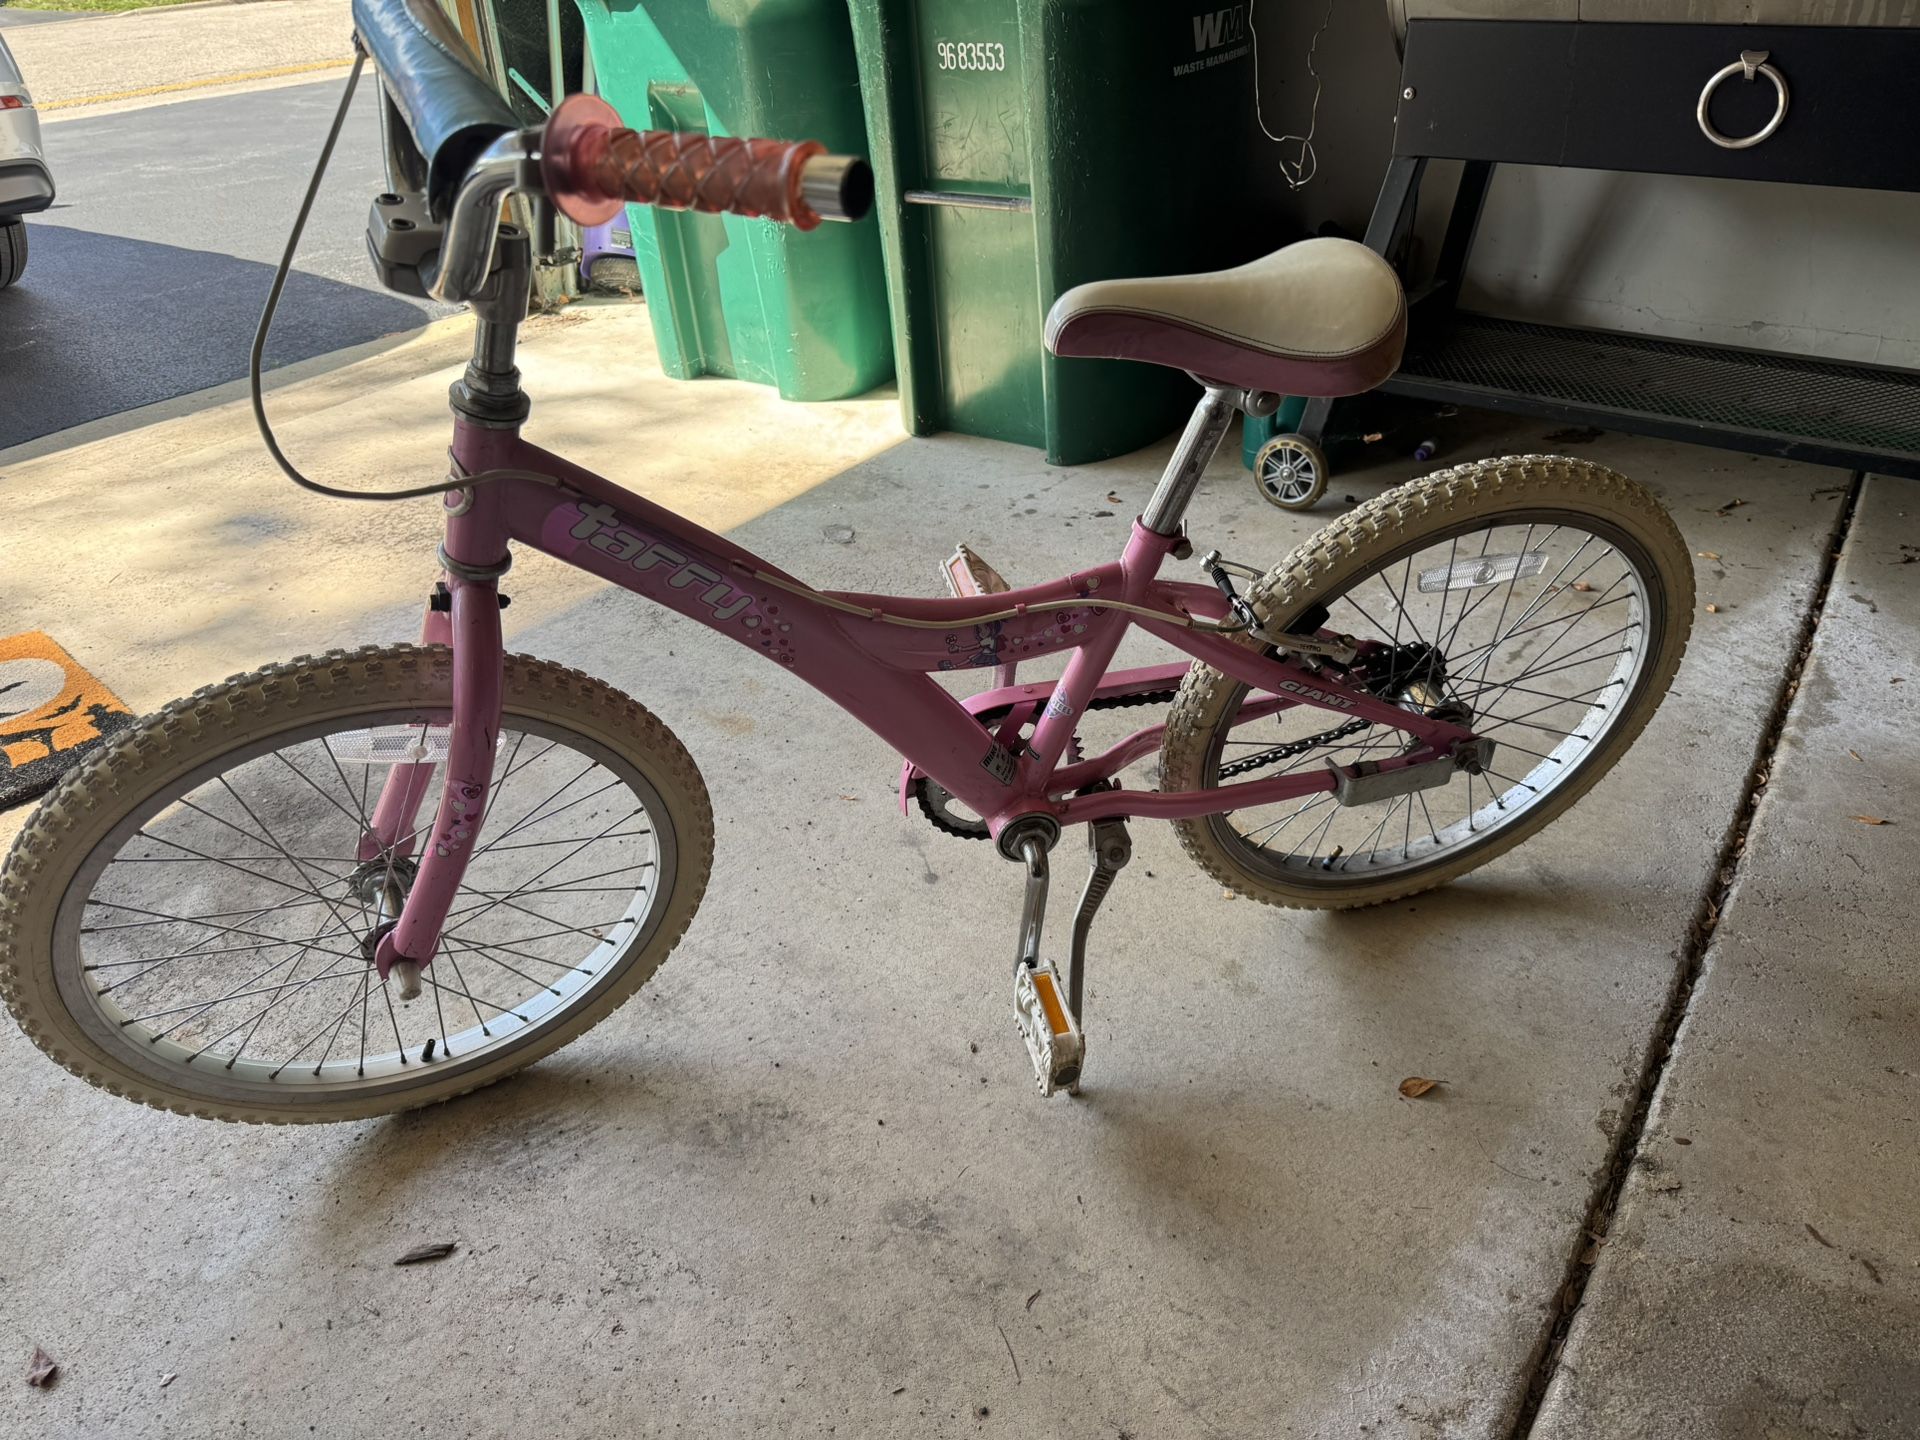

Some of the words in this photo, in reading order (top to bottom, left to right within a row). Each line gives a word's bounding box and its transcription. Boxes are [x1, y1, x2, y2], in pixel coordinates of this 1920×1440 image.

[1192, 4, 1244, 53] WM
[937, 42, 1005, 71] 9683553
[1173, 59, 1205, 77] WASTE
[1279, 680, 1357, 709] GIANT
